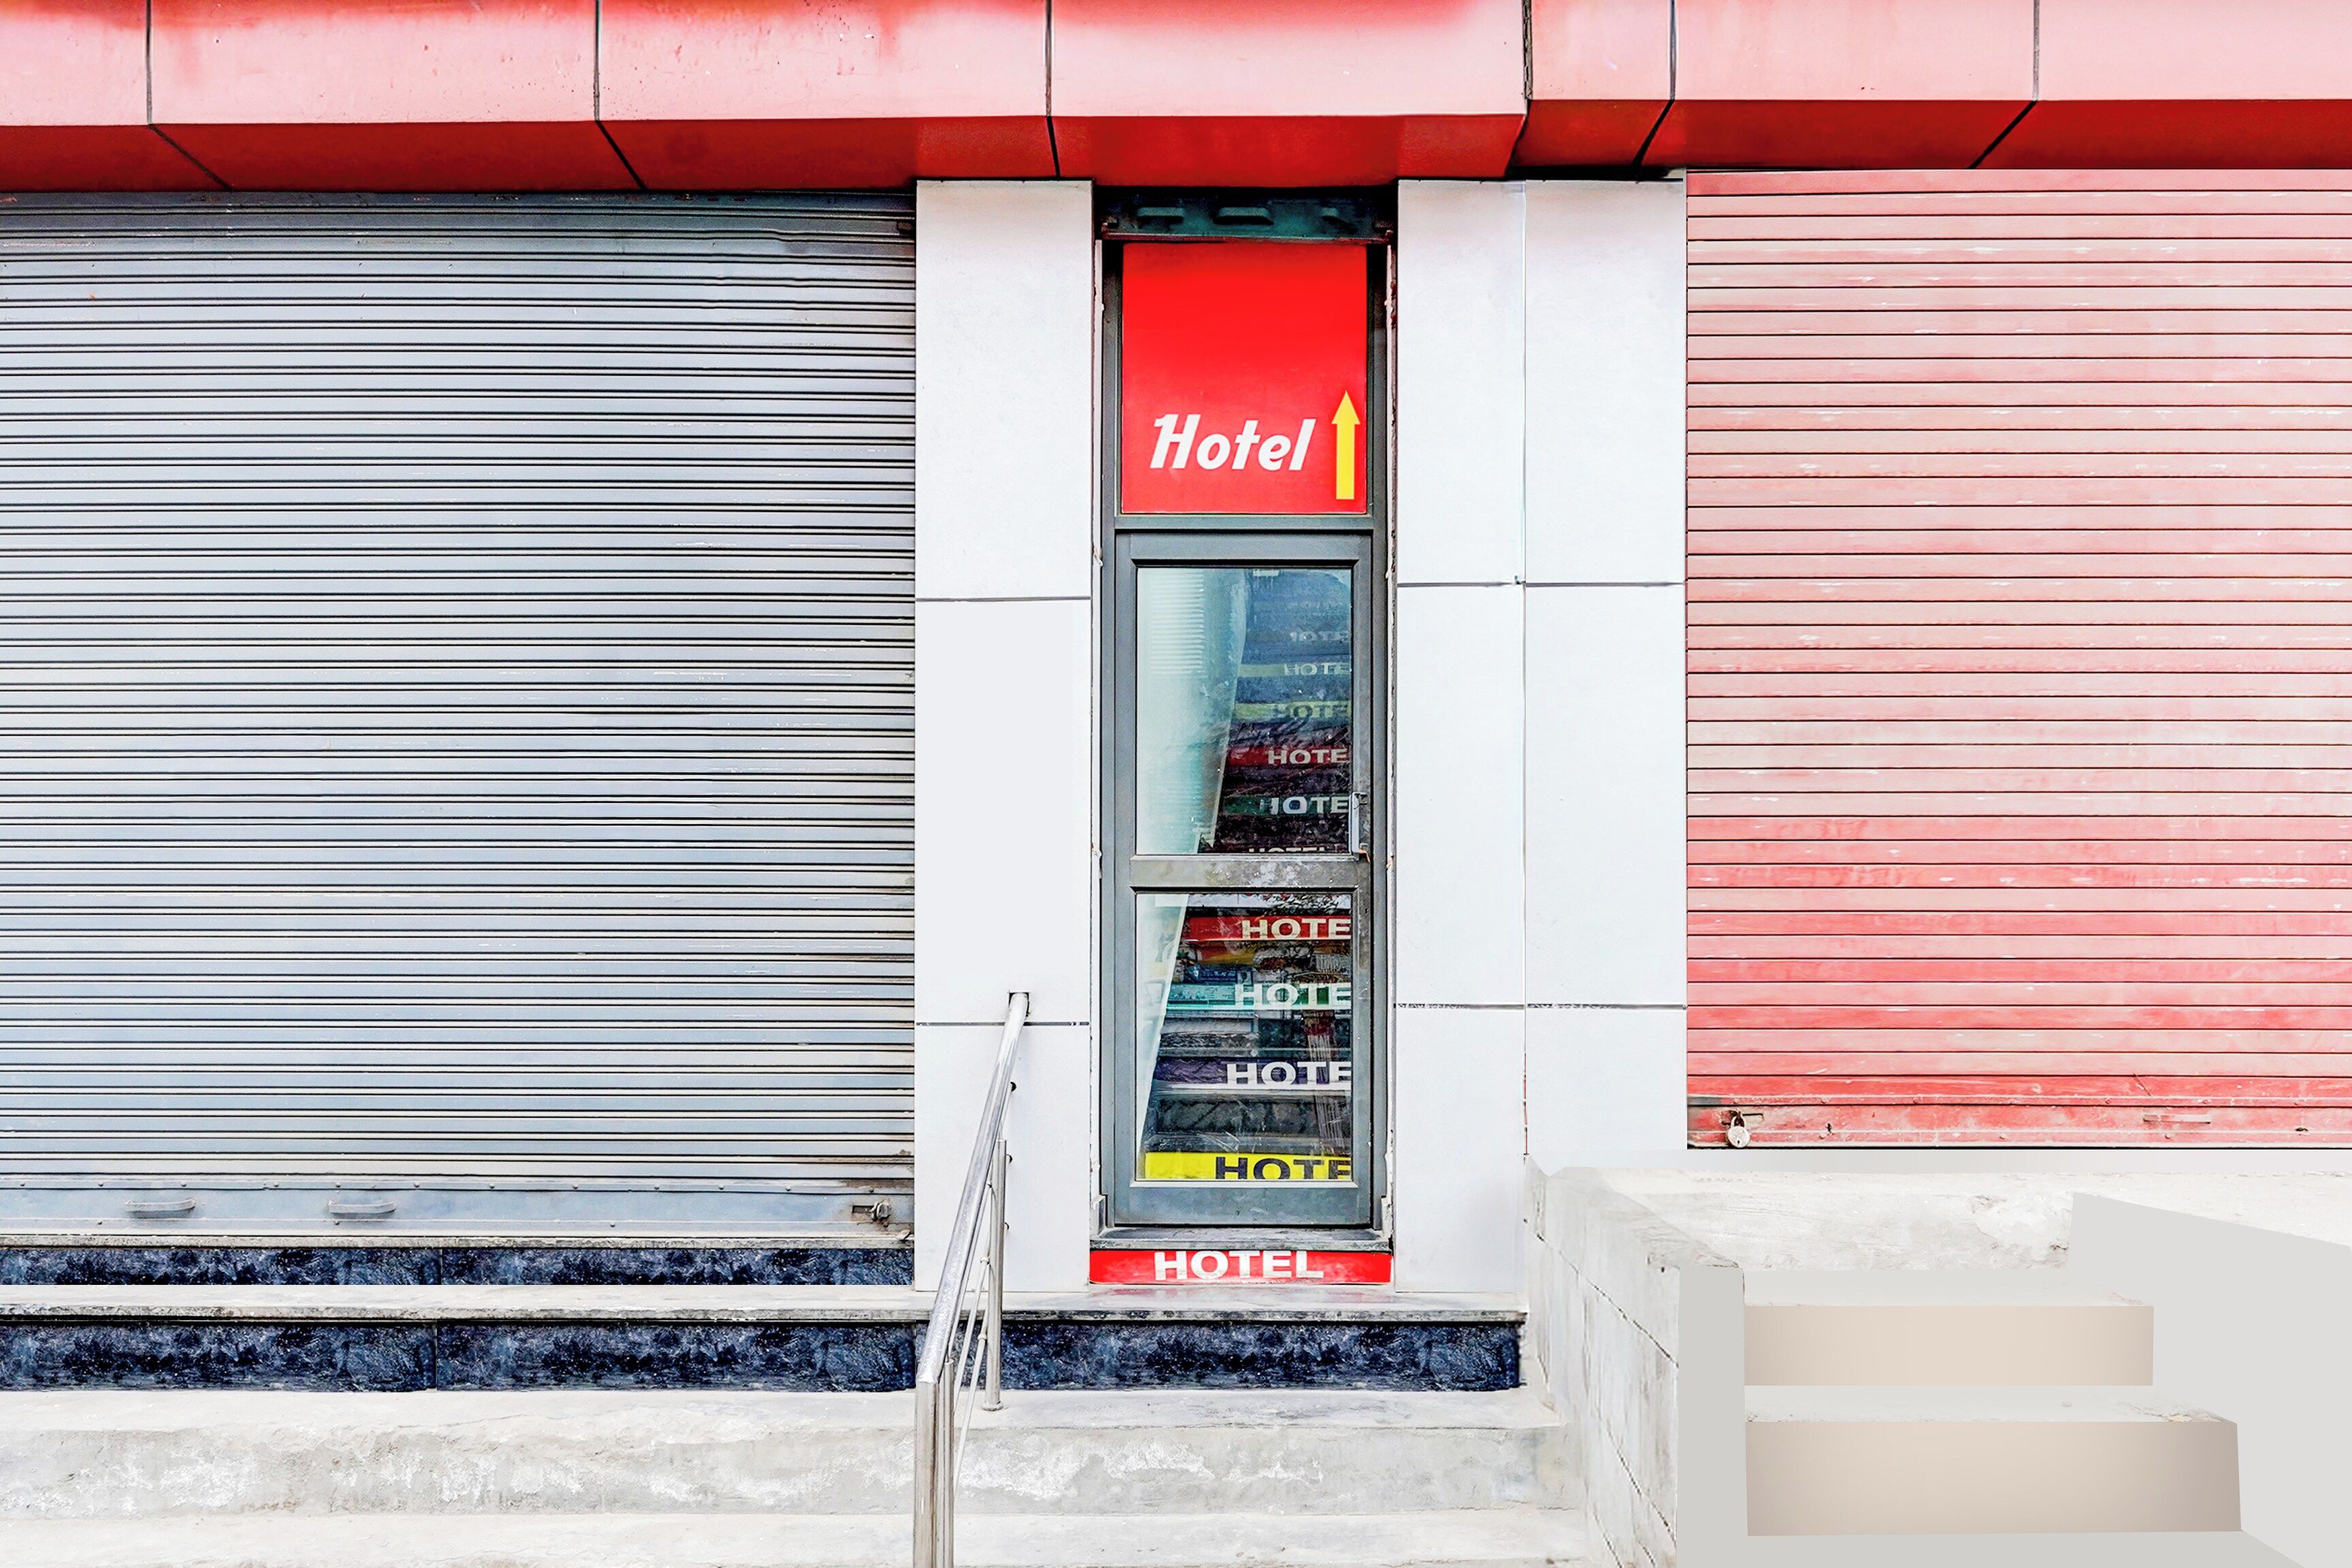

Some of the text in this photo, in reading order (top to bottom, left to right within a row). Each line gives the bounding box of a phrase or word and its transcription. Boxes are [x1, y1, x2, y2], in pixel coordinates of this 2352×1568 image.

[1149, 414, 1316, 471] Hotel
[1267, 749, 1351, 765] HOTE
[1241, 919, 1351, 940] HOTE
[1235, 983, 1351, 1007] HOTE
[1226, 1061, 1352, 1087] HOTE
[1154, 1250, 1324, 1280] HOTEL
